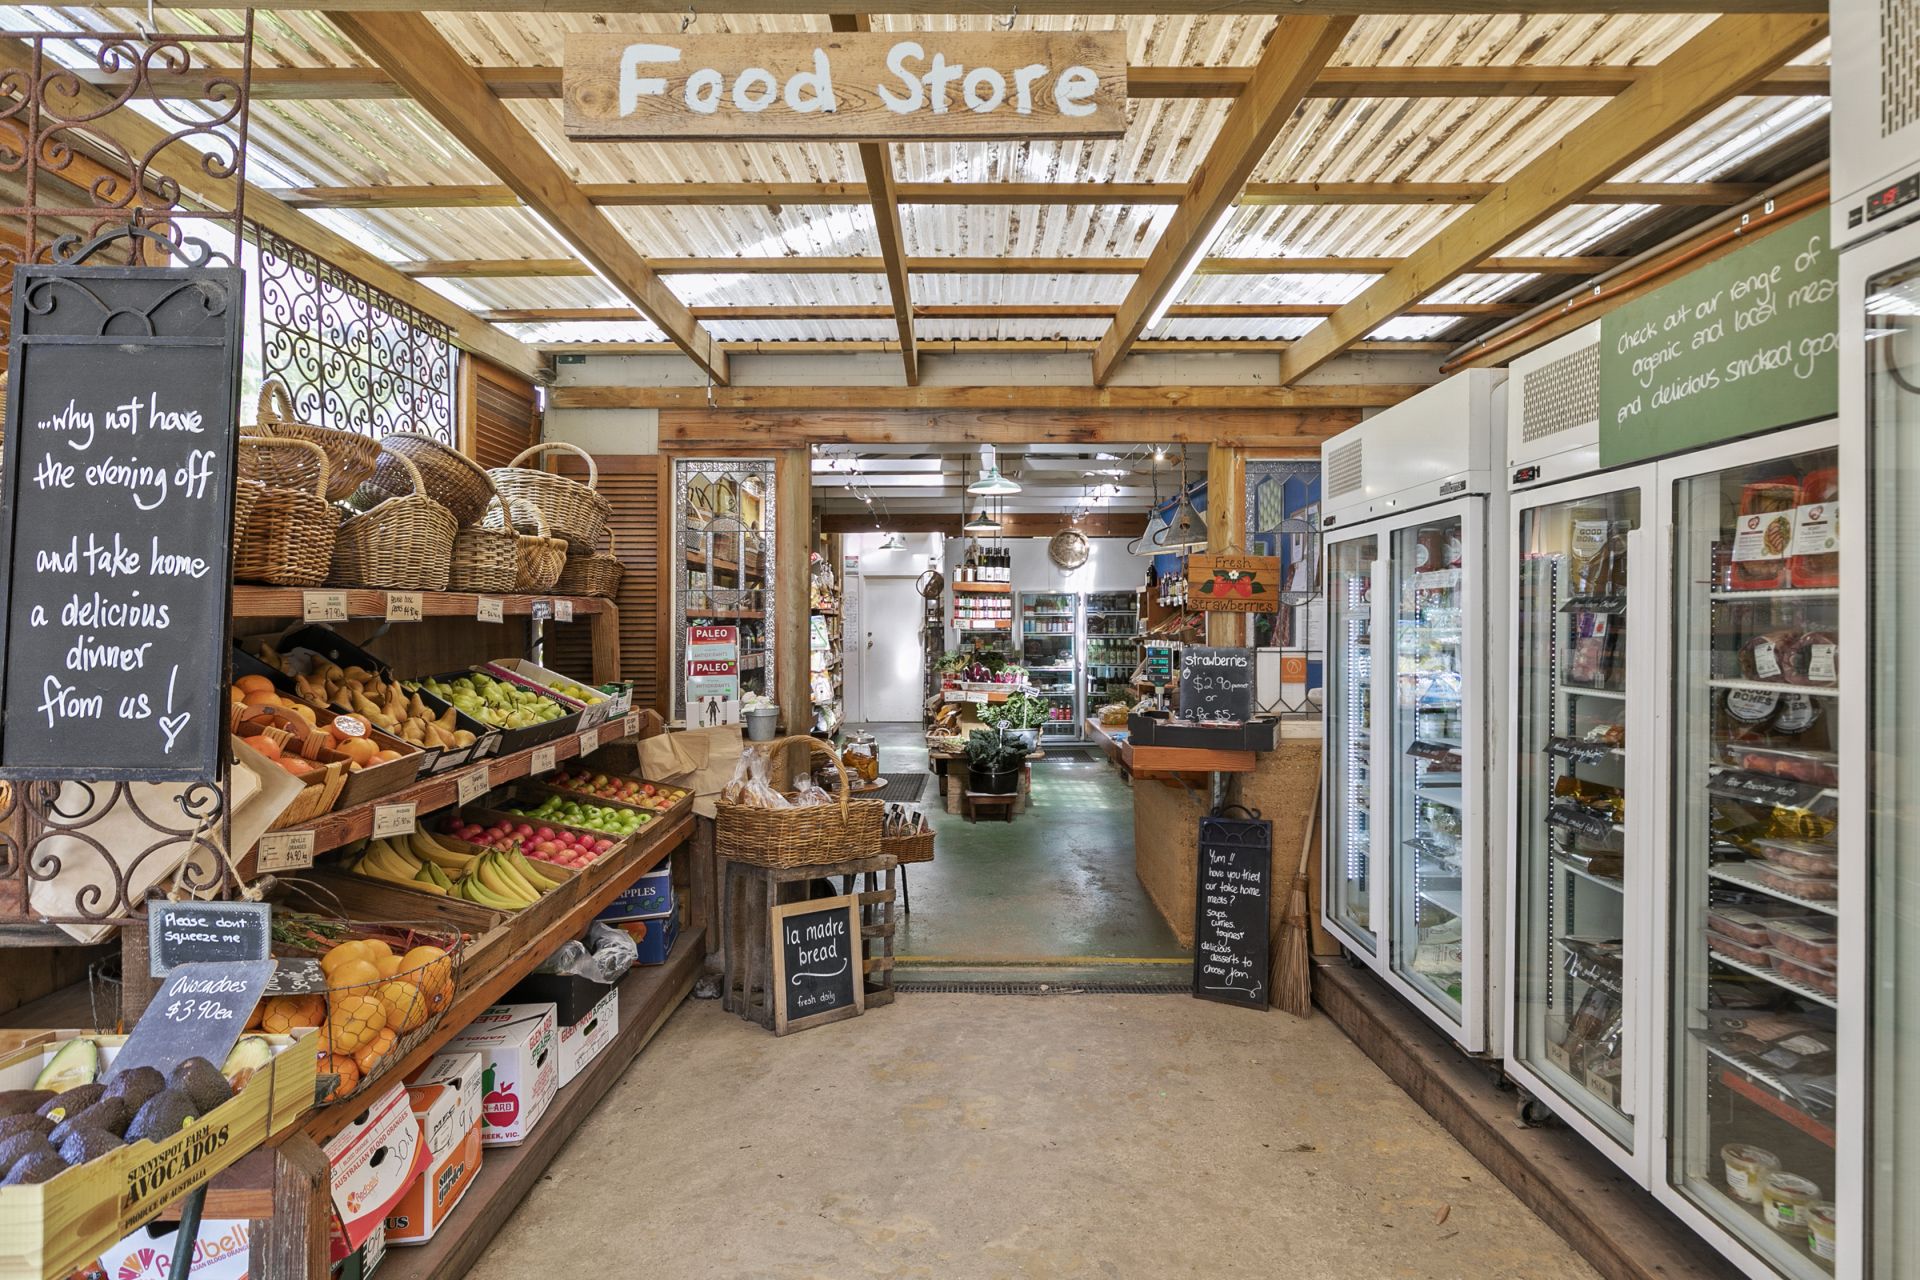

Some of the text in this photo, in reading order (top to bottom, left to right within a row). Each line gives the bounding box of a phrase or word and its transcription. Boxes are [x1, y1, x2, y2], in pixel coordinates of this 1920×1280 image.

[620, 41, 1101, 117] Food Store
[1617, 235, 1822, 356] Check out our range of
[1632, 339, 1683, 389] organic
[1691, 319, 1724, 350] and
[1734, 291, 1777, 333] local
[1617, 396, 1642, 425] and
[1651, 368, 1721, 409] delicious
[1724, 340, 1793, 383] smoked
[105, 396, 145, 435] not
[149, 391, 205, 434] have
[33, 449, 216, 511] the evening off
[36, 532, 211, 579] and take home
[1215, 556, 1253, 569] Fresh
[30, 590, 171, 630] a delicious
[1190, 600, 1274, 612] Strawberries
[696, 629, 729, 639] PALEO
[66, 634, 153, 673] dinner
[696, 662, 729, 672] PALEO
[37, 674, 103, 729] from
[1732, 691, 1774, 707] BONES
[1184, 708, 1196, 719] 2
[1196, 706, 1211, 720] for
[1209, 849, 1227, 865] Yum
[1226, 870, 1241, 883] you
[1241, 868, 1261, 884] tried
[1205, 881, 1261, 897] our take home
[164, 911, 247, 929] Please dont
[786, 916, 846, 946] la madre
[222, 934, 242, 944] me
[1201, 941, 1232, 954] delicious
[798, 937, 838, 967] bread
[1209, 953, 1253, 968] desserts to
[168, 974, 249, 998] Avocadoes
[797, 990, 837, 1008] fresh daily
[482, 1101, 514, 1114] N-ARD
[127, 1124, 210, 1185] SUNNYSPOT FARM
[334, 1151, 371, 1192] AUSTRALIAN
[369, 1131, 389, 1154] BLOOD
[386, 1111, 410, 1137] ORANGES
[123, 1123, 230, 1210] AVOCADOS
[124, 1168, 207, 1230] PRODUCE OF AUSTRALIA
[386, 1216, 410, 1230] US
